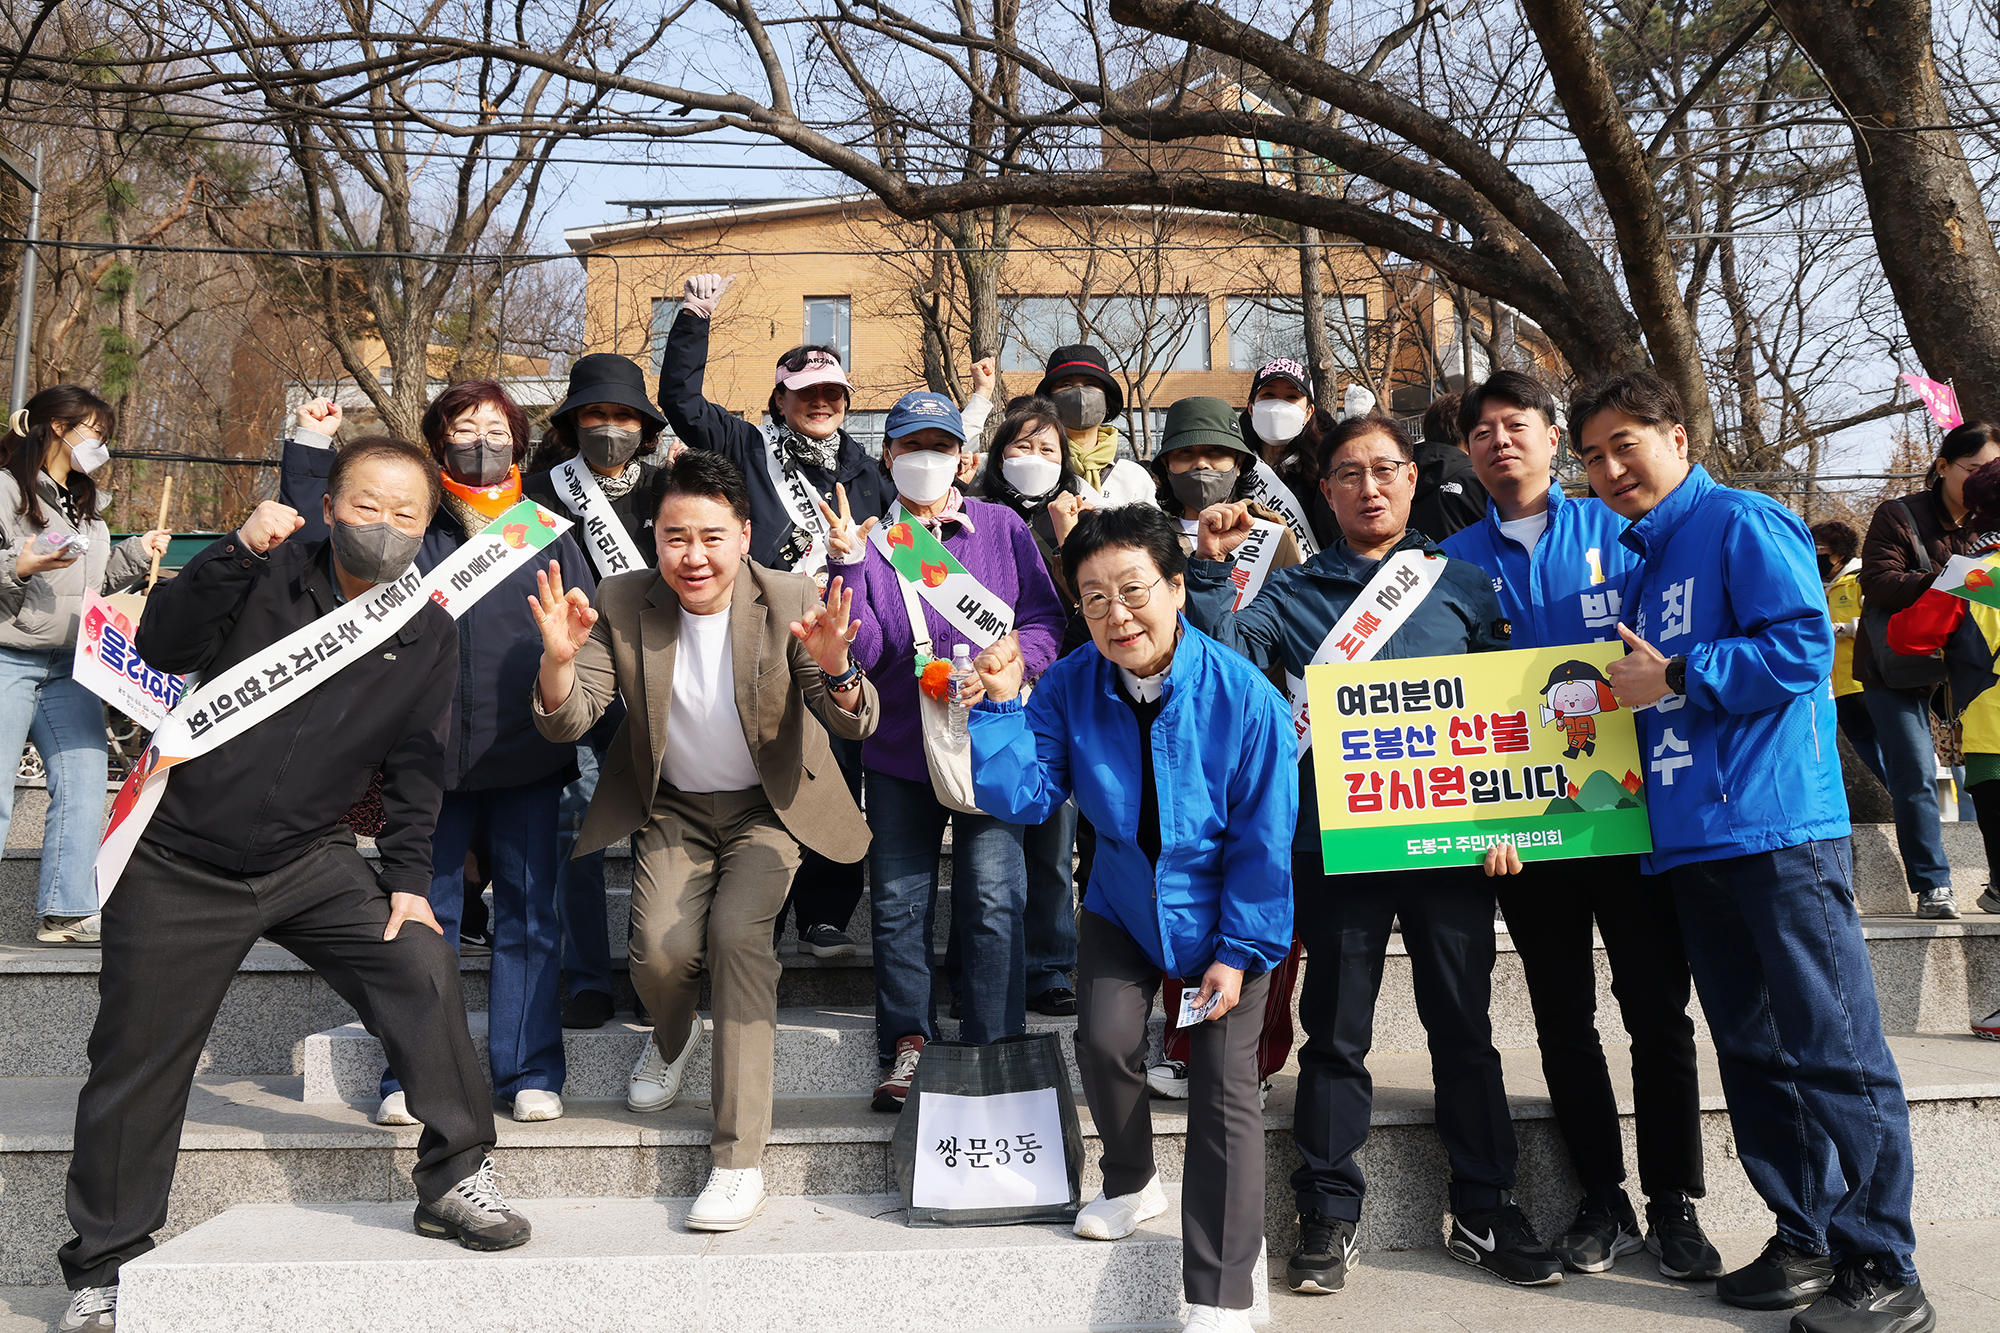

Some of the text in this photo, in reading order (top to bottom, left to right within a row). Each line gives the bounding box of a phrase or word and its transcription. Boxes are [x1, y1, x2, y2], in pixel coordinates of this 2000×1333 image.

[450, 542, 508, 592] 산불은
[1585, 547, 1606, 586] 1
[1335, 565, 1420, 661] 작은 불씨
[186, 572, 422, 740] 도봉구 주민자치협의회
[1336, 676, 1466, 716] 여러분이
[1341, 710, 1531, 761] 도봉산 산불
[1344, 764, 1569, 813] 감시원입니다
[1406, 829, 1563, 856] 도봉구 주민자치협의회
[934, 1132, 1044, 1169] 쌍문3동
